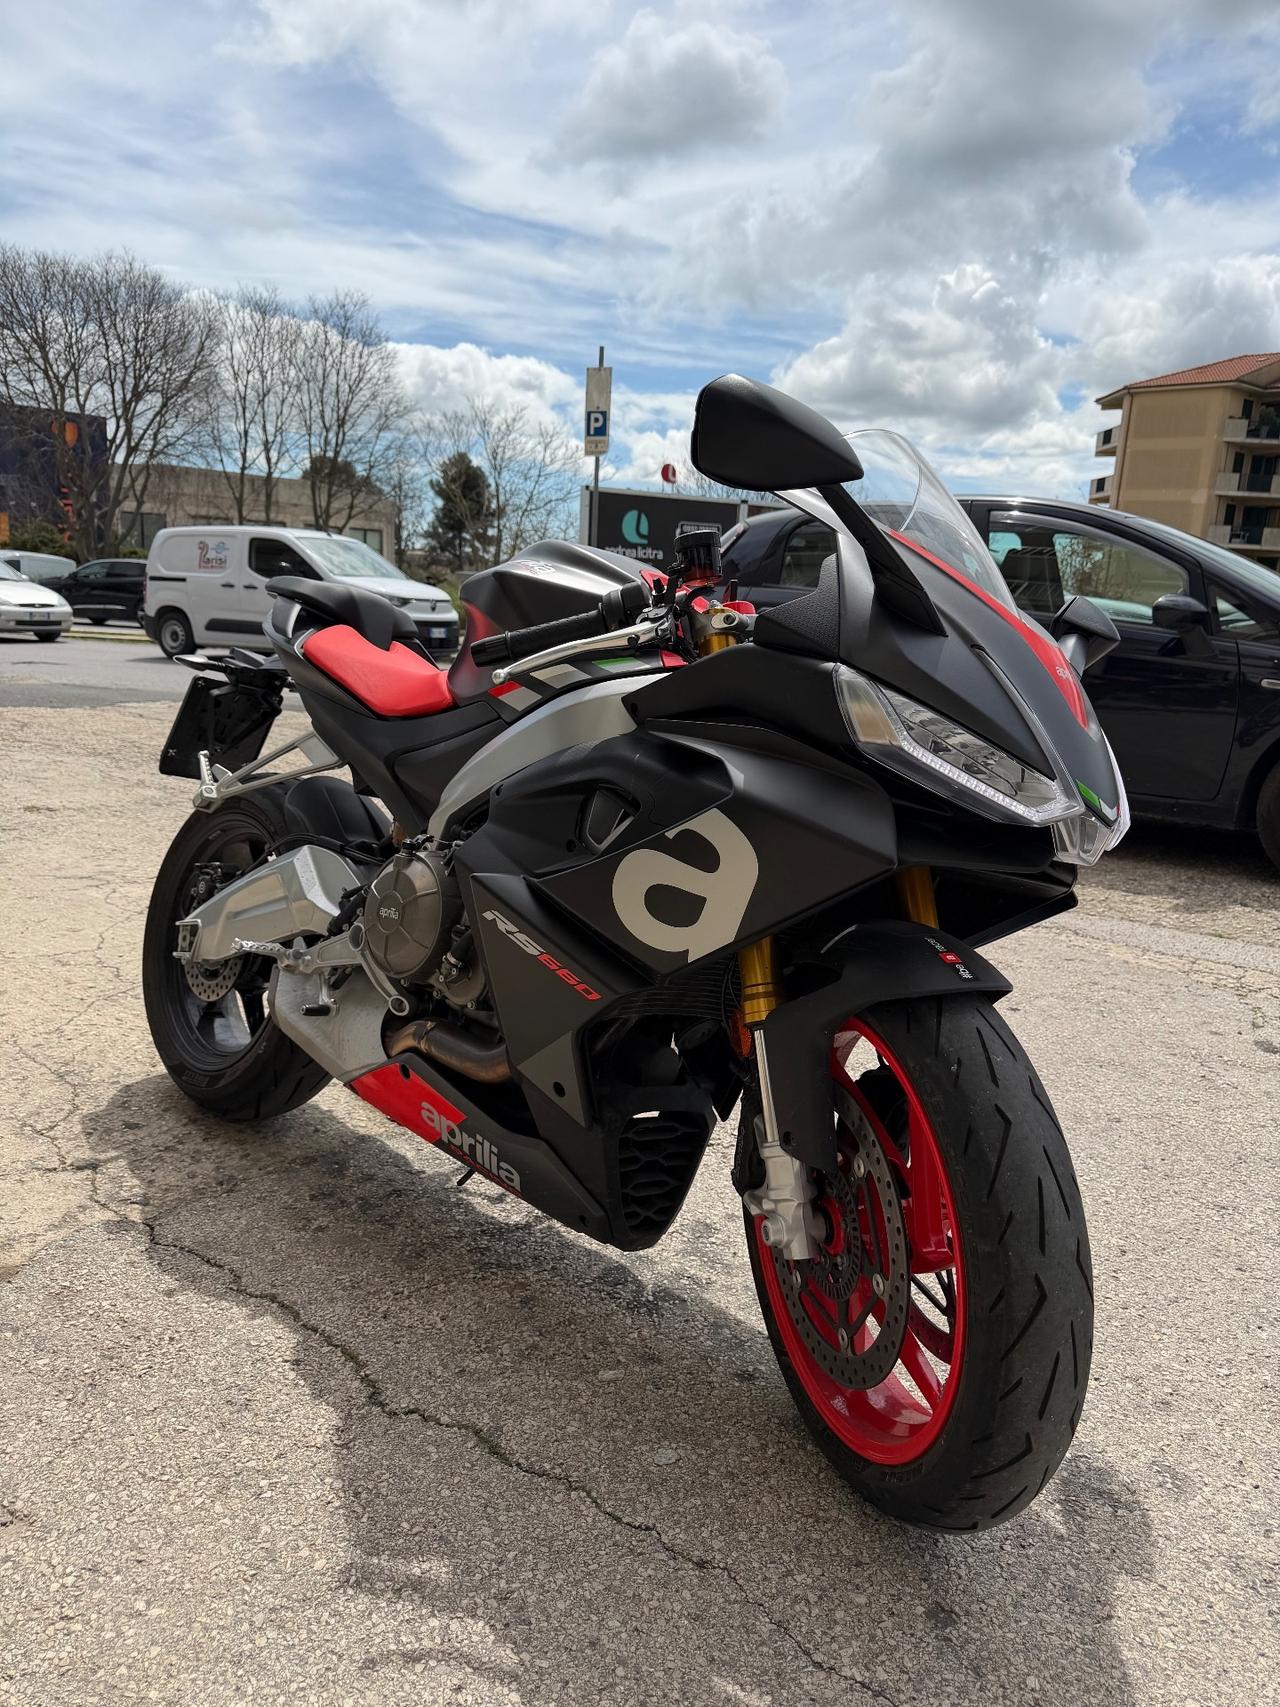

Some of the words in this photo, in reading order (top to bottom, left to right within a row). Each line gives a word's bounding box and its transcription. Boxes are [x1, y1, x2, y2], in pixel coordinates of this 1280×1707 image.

[589, 412, 603, 435] P
[604, 545, 636, 558] ndrea
[379, 907, 399, 920] aprilia
[420, 1100, 522, 1193] aprilia
